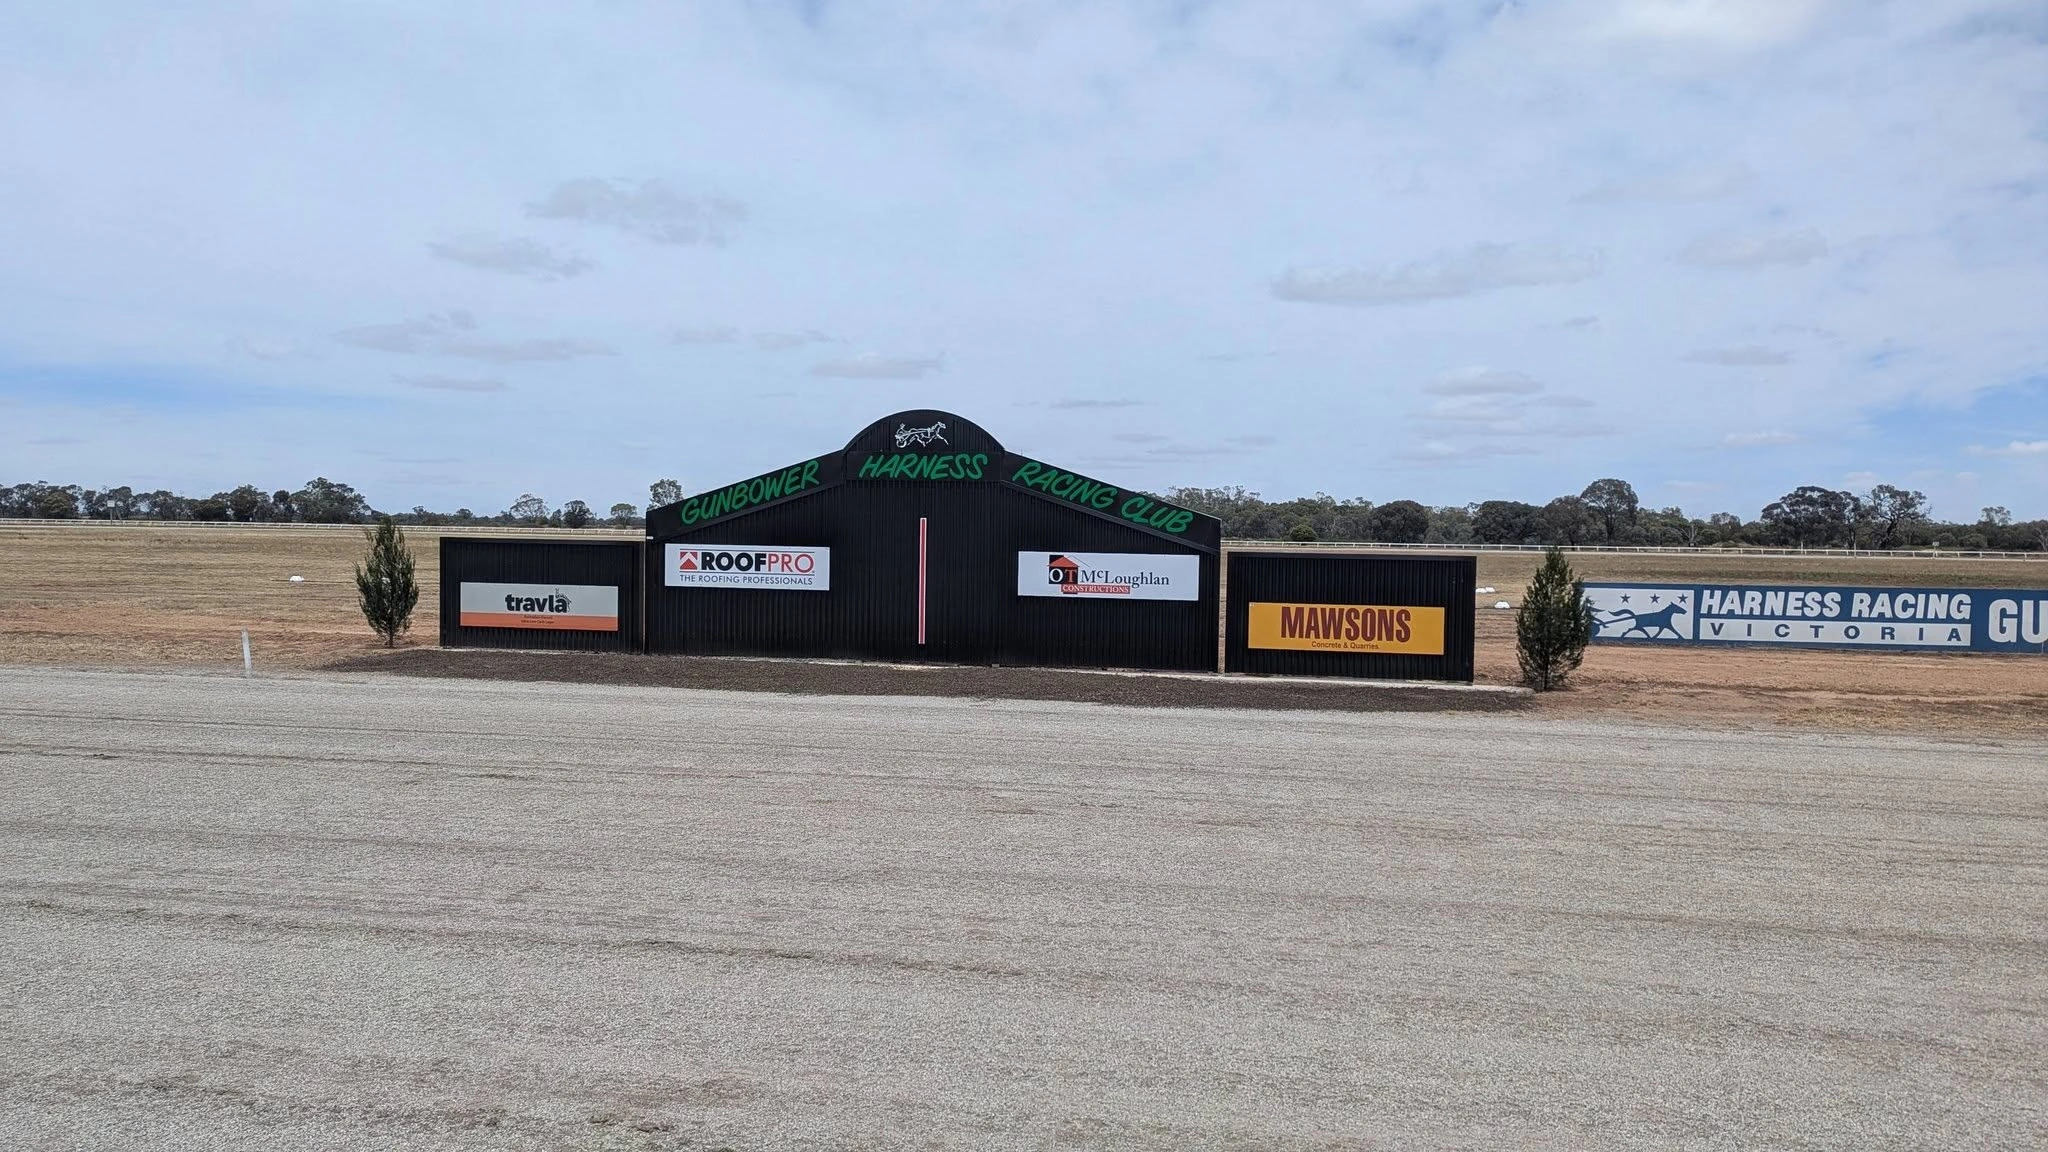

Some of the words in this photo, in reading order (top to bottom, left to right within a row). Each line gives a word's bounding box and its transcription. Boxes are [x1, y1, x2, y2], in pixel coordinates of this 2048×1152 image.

[681, 459, 820, 525] GUNBOWER
[858, 453, 987, 480] HARNESS
[1012, 461, 1119, 509] RACING
[1121, 497, 1194, 533] CLUB
[701, 551, 815, 573] ROOFPRO
[680, 574, 696, 583] THE
[699, 575, 740, 584] ROOFING
[742, 576, 813, 585] PROFESSIONALS
[1081, 569, 1170, 589] McLoughlan
[1062, 585, 1130, 594] CONSTRUCTIONS
[504, 593, 568, 613] travla
[1700, 590, 1841, 618] HARNESS
[1850, 592, 1971, 620] RACING
[1281, 606, 1411, 643] MAWSONS
[1709, 622, 1962, 642] VICTORIA
[1311, 641, 1342, 649] Concrete
